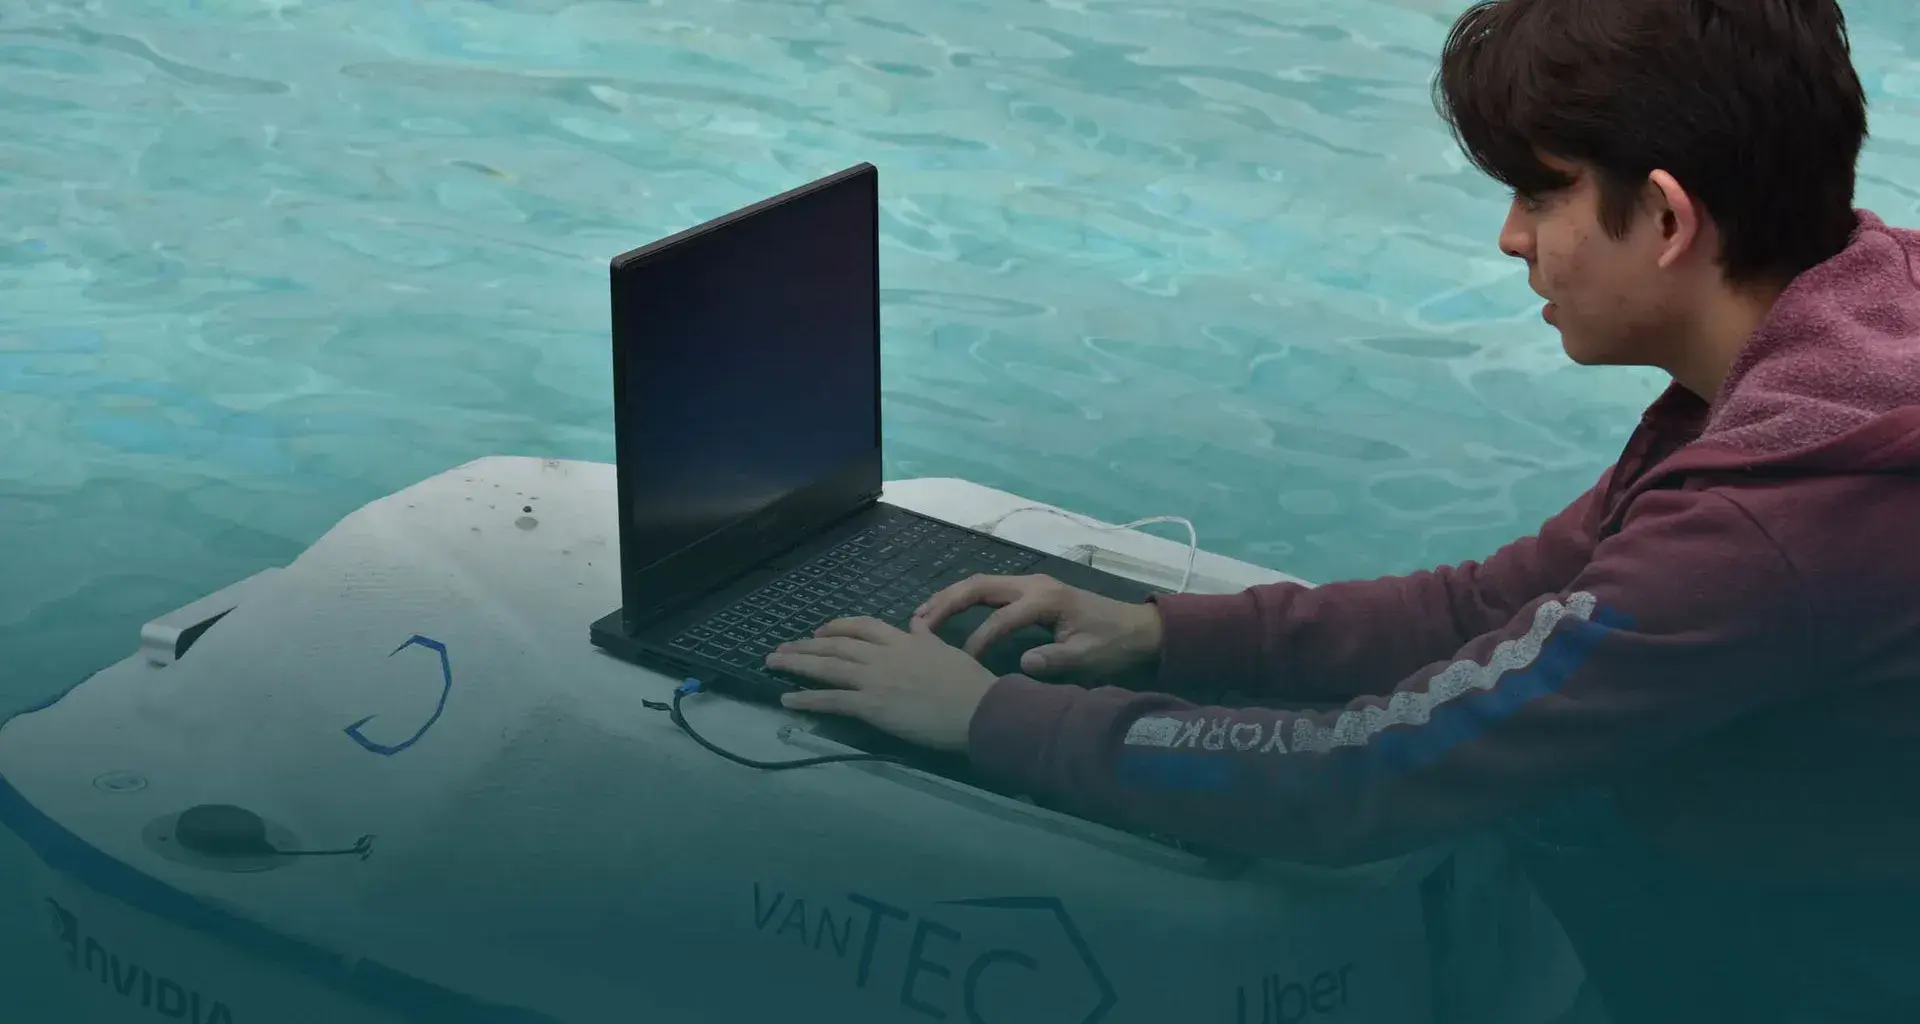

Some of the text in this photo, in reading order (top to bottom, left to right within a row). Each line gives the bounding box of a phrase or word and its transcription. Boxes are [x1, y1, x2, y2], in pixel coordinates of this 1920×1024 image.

[1177, 716, 1289, 754] YORK
[752, 881, 1040, 1024] VANTEC
[1236, 962, 1354, 1024] Uber
